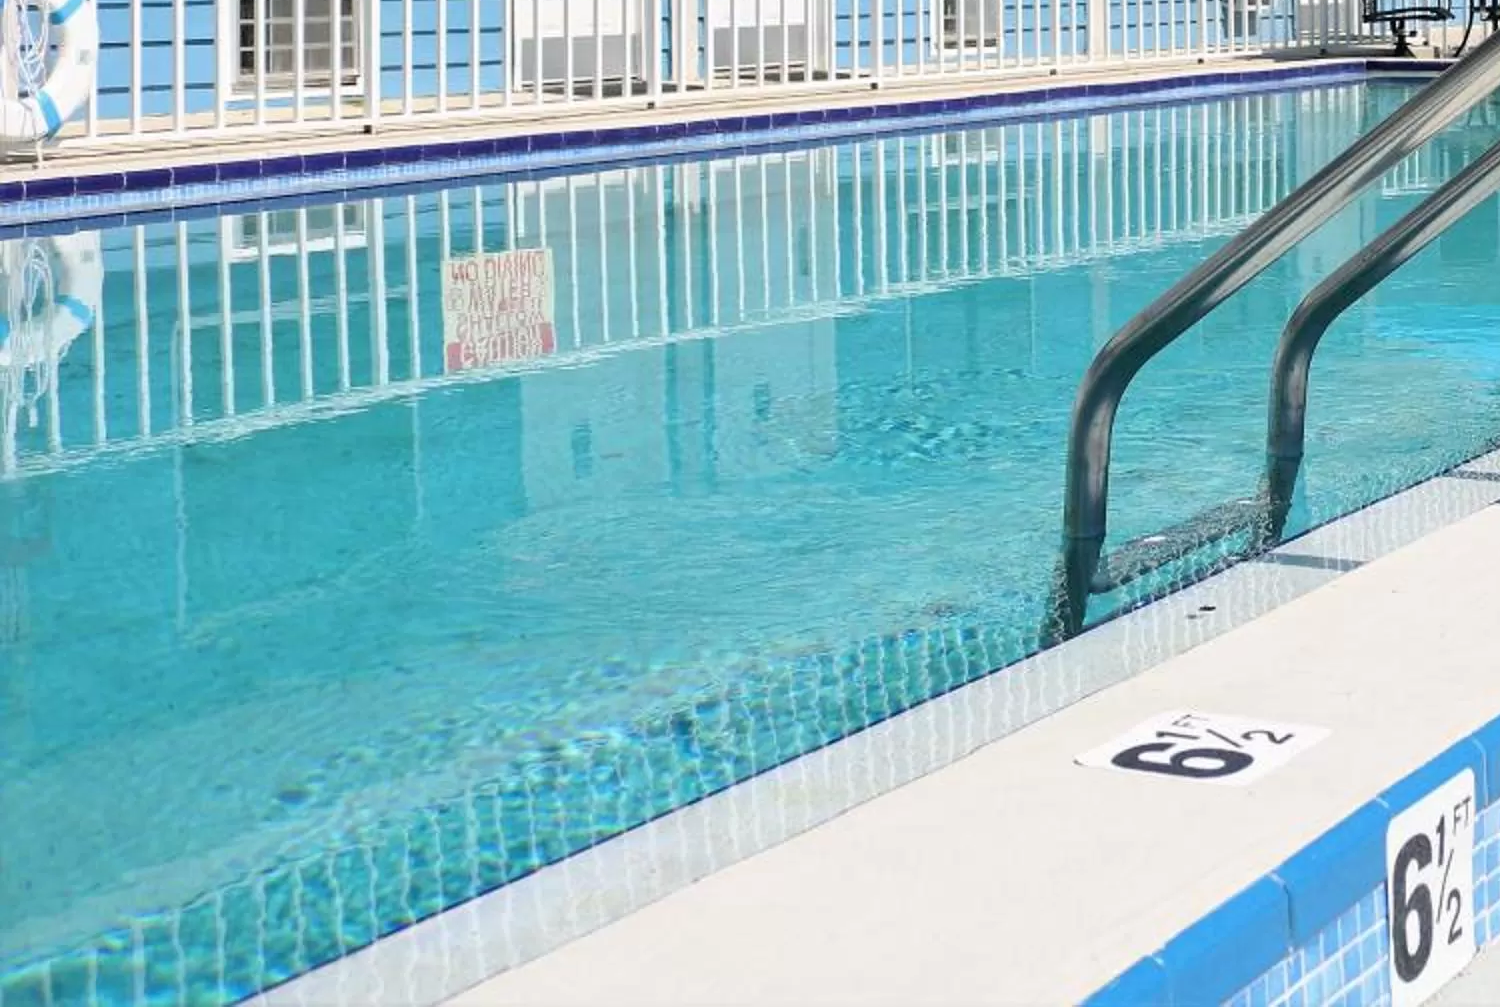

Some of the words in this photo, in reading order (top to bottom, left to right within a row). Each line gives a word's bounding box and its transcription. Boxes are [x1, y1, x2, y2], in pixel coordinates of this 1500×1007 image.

[1110, 741, 1255, 779] 6
[1453, 795, 1472, 837] FT
[1392, 832, 1434, 984] 6
